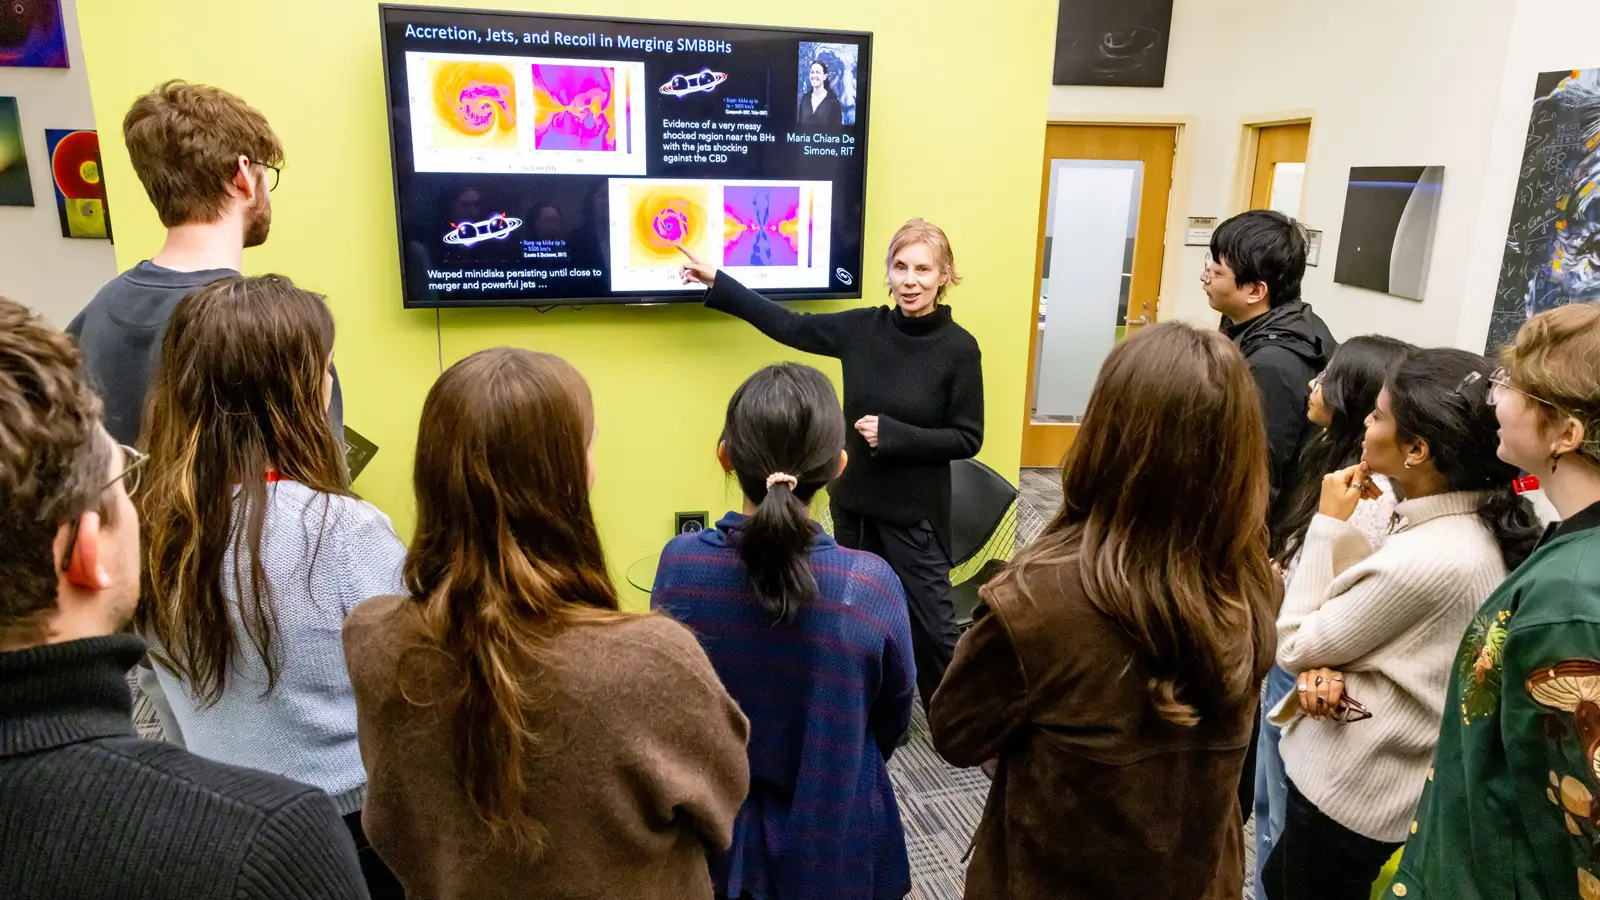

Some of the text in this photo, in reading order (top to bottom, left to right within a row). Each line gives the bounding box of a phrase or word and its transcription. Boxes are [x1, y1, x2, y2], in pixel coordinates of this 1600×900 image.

[405, 23, 732, 54] Accretion, Jets, and Recoil in Merging SMBBHs
[663, 119, 700, 129] Evidence
[702, 120, 711, 129] of
[719, 123, 736, 132] very
[737, 123, 762, 132] messy
[663, 131, 696, 140] shocked
[698, 132, 724, 142] region
[745, 132, 758, 142] the
[760, 133, 776, 142] BHs
[786, 133, 855, 144] Maria Chiara De
[663, 142, 748, 154] with the jets shocking
[804, 146, 854, 156] Simone, RIT
[663, 154, 728, 164] against the CBD
[427, 268, 602, 280] Warped minidisks persisting until close to
[428, 282, 460, 292] merger
[462, 280, 480, 290] and
[482, 280, 518, 292] powerful
[520, 280, 536, 290] jets
